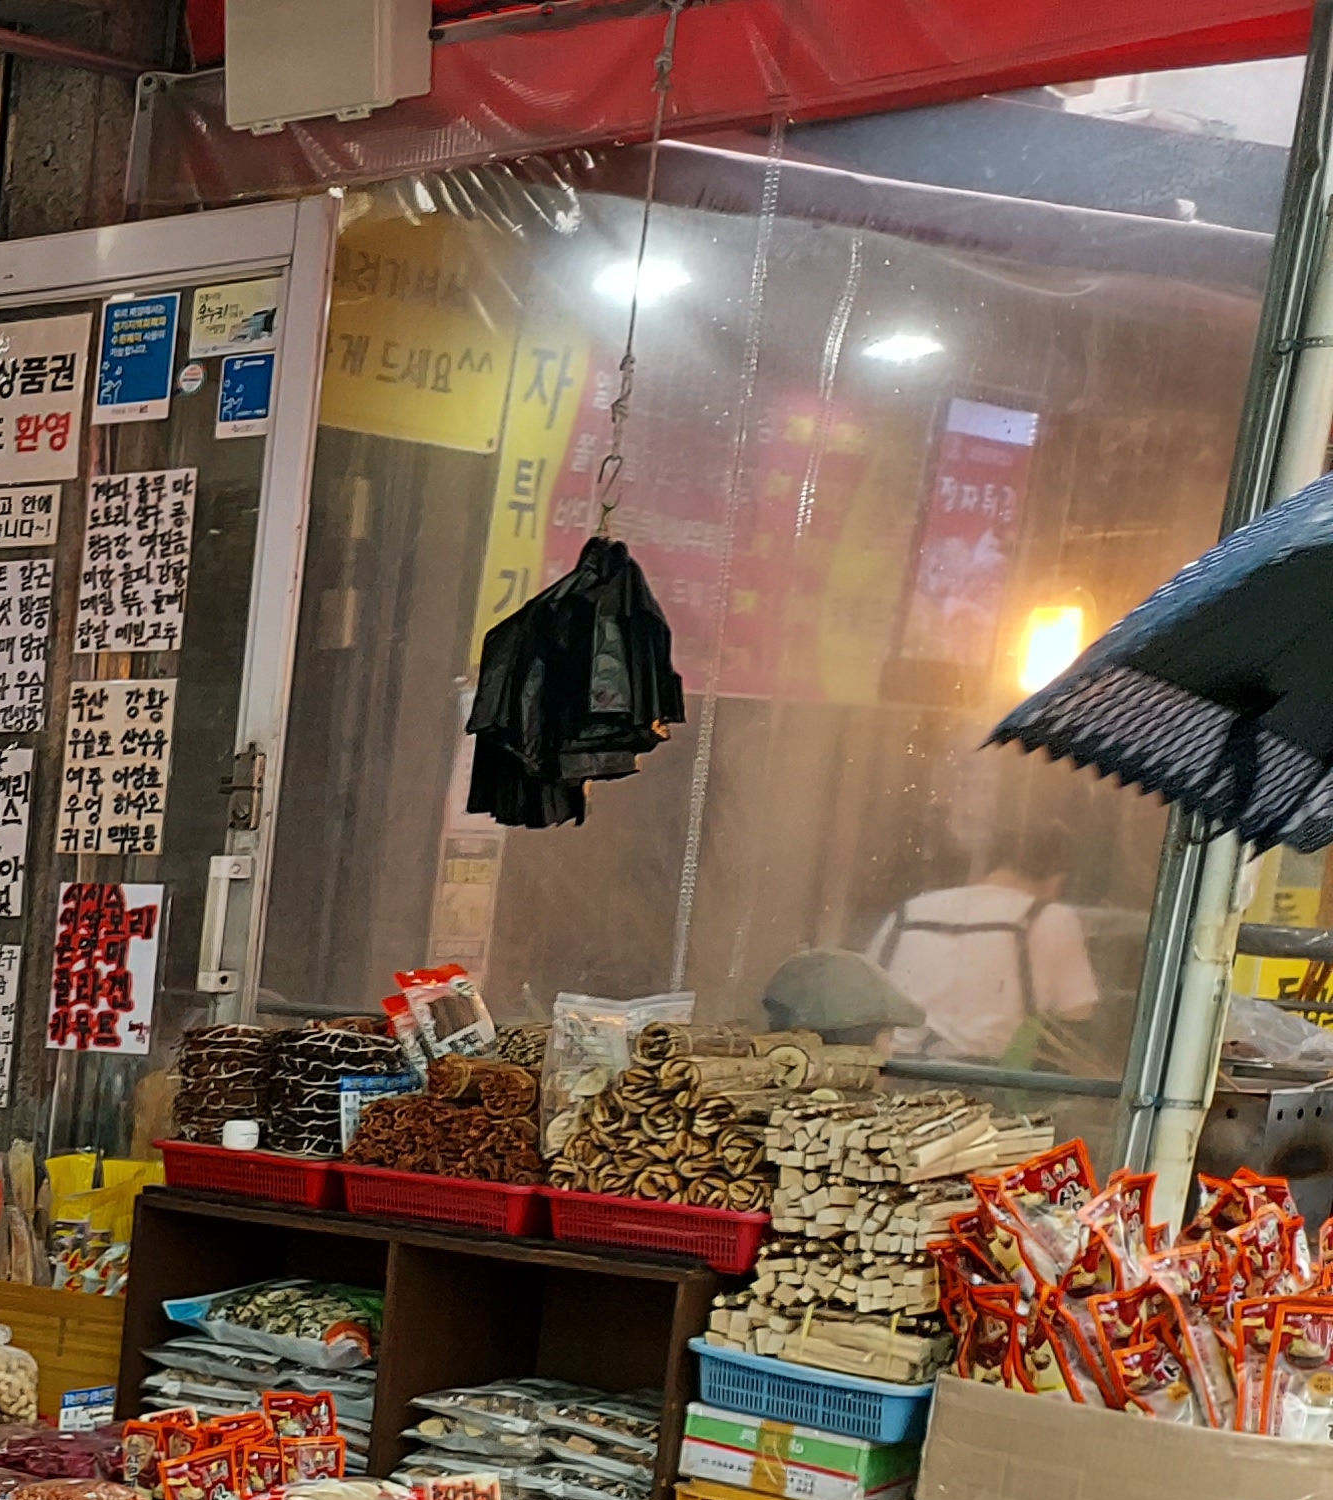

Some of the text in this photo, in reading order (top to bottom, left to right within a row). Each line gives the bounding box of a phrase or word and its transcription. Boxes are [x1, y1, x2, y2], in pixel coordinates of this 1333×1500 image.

[15, 411, 72, 454] 환영
[173, 474, 193, 495] 마
[21, 493, 52, 515] 안에
[20, 562, 51, 593] 갈근
[20, 634, 48, 662] 당귀
[14, 669, 45, 700] 우슬
[125, 687, 169, 723] 강황
[120, 727, 168, 760] 산수유
[66, 766, 105, 796] 여주
[64, 791, 163, 825] 우엉 하수오
[61, 823, 157, 852] 귀리 맥문동
